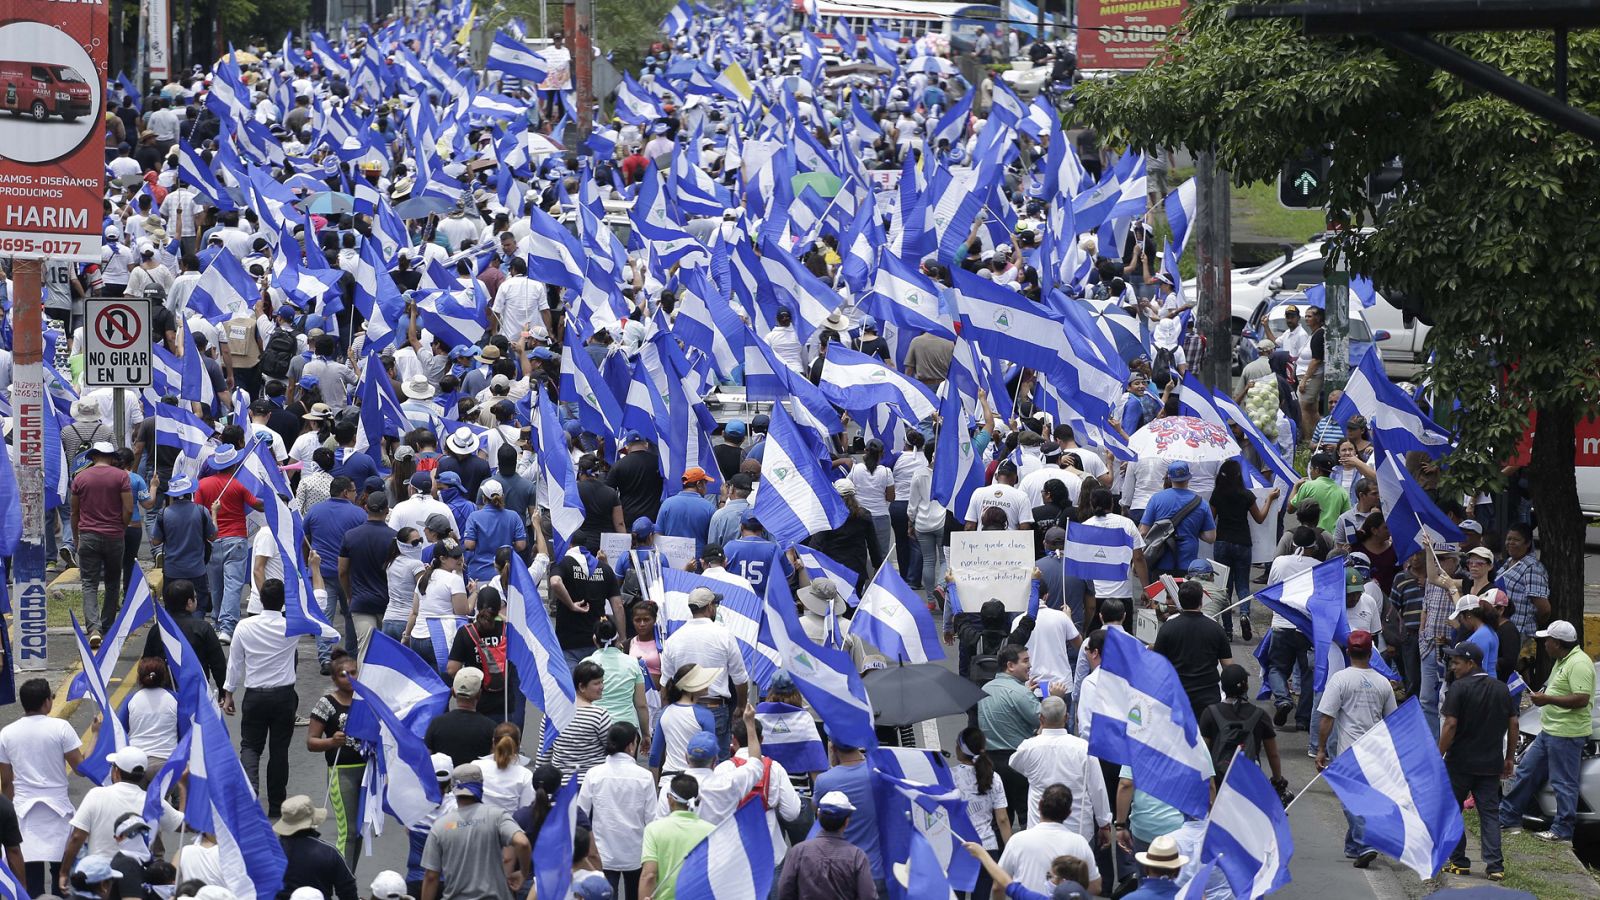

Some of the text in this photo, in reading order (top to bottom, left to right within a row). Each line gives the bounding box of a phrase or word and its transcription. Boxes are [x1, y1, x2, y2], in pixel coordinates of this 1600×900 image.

[1100, 0, 1181, 16] MUNDIALISTA
[1098, 25, 1167, 44] $3,000
[40, 176, 98, 187] DISEÑAMOS
[0, 187, 63, 198] PRODUCIMOS
[6, 205, 88, 229] HARIM
[0, 238, 82, 255] 695-0177
[50, 266, 68, 284] 16
[89, 351, 148, 366] NO GIRAR
[97, 367, 141, 383] EN U
[961, 540, 966, 550] Y
[969, 544, 979, 554] que
[984, 540, 1004, 551] quede
[739, 560, 764, 585] 15
